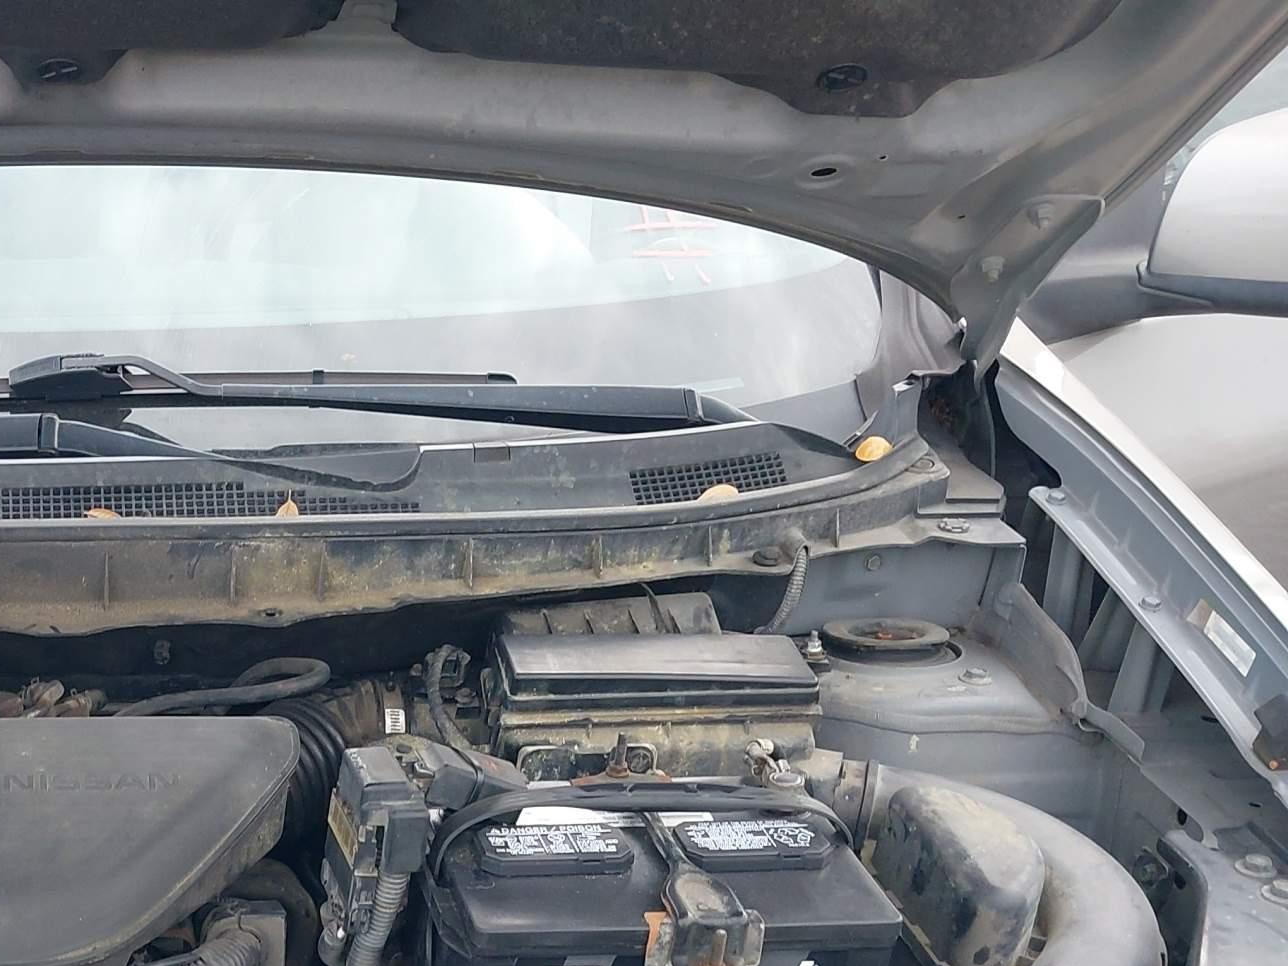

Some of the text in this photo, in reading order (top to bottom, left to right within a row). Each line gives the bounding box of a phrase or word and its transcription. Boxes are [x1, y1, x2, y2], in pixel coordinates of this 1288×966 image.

[3, 773, 182, 793] NISSAN
[501, 826, 548, 836] DANGER
[559, 824, 602, 834] POISON
